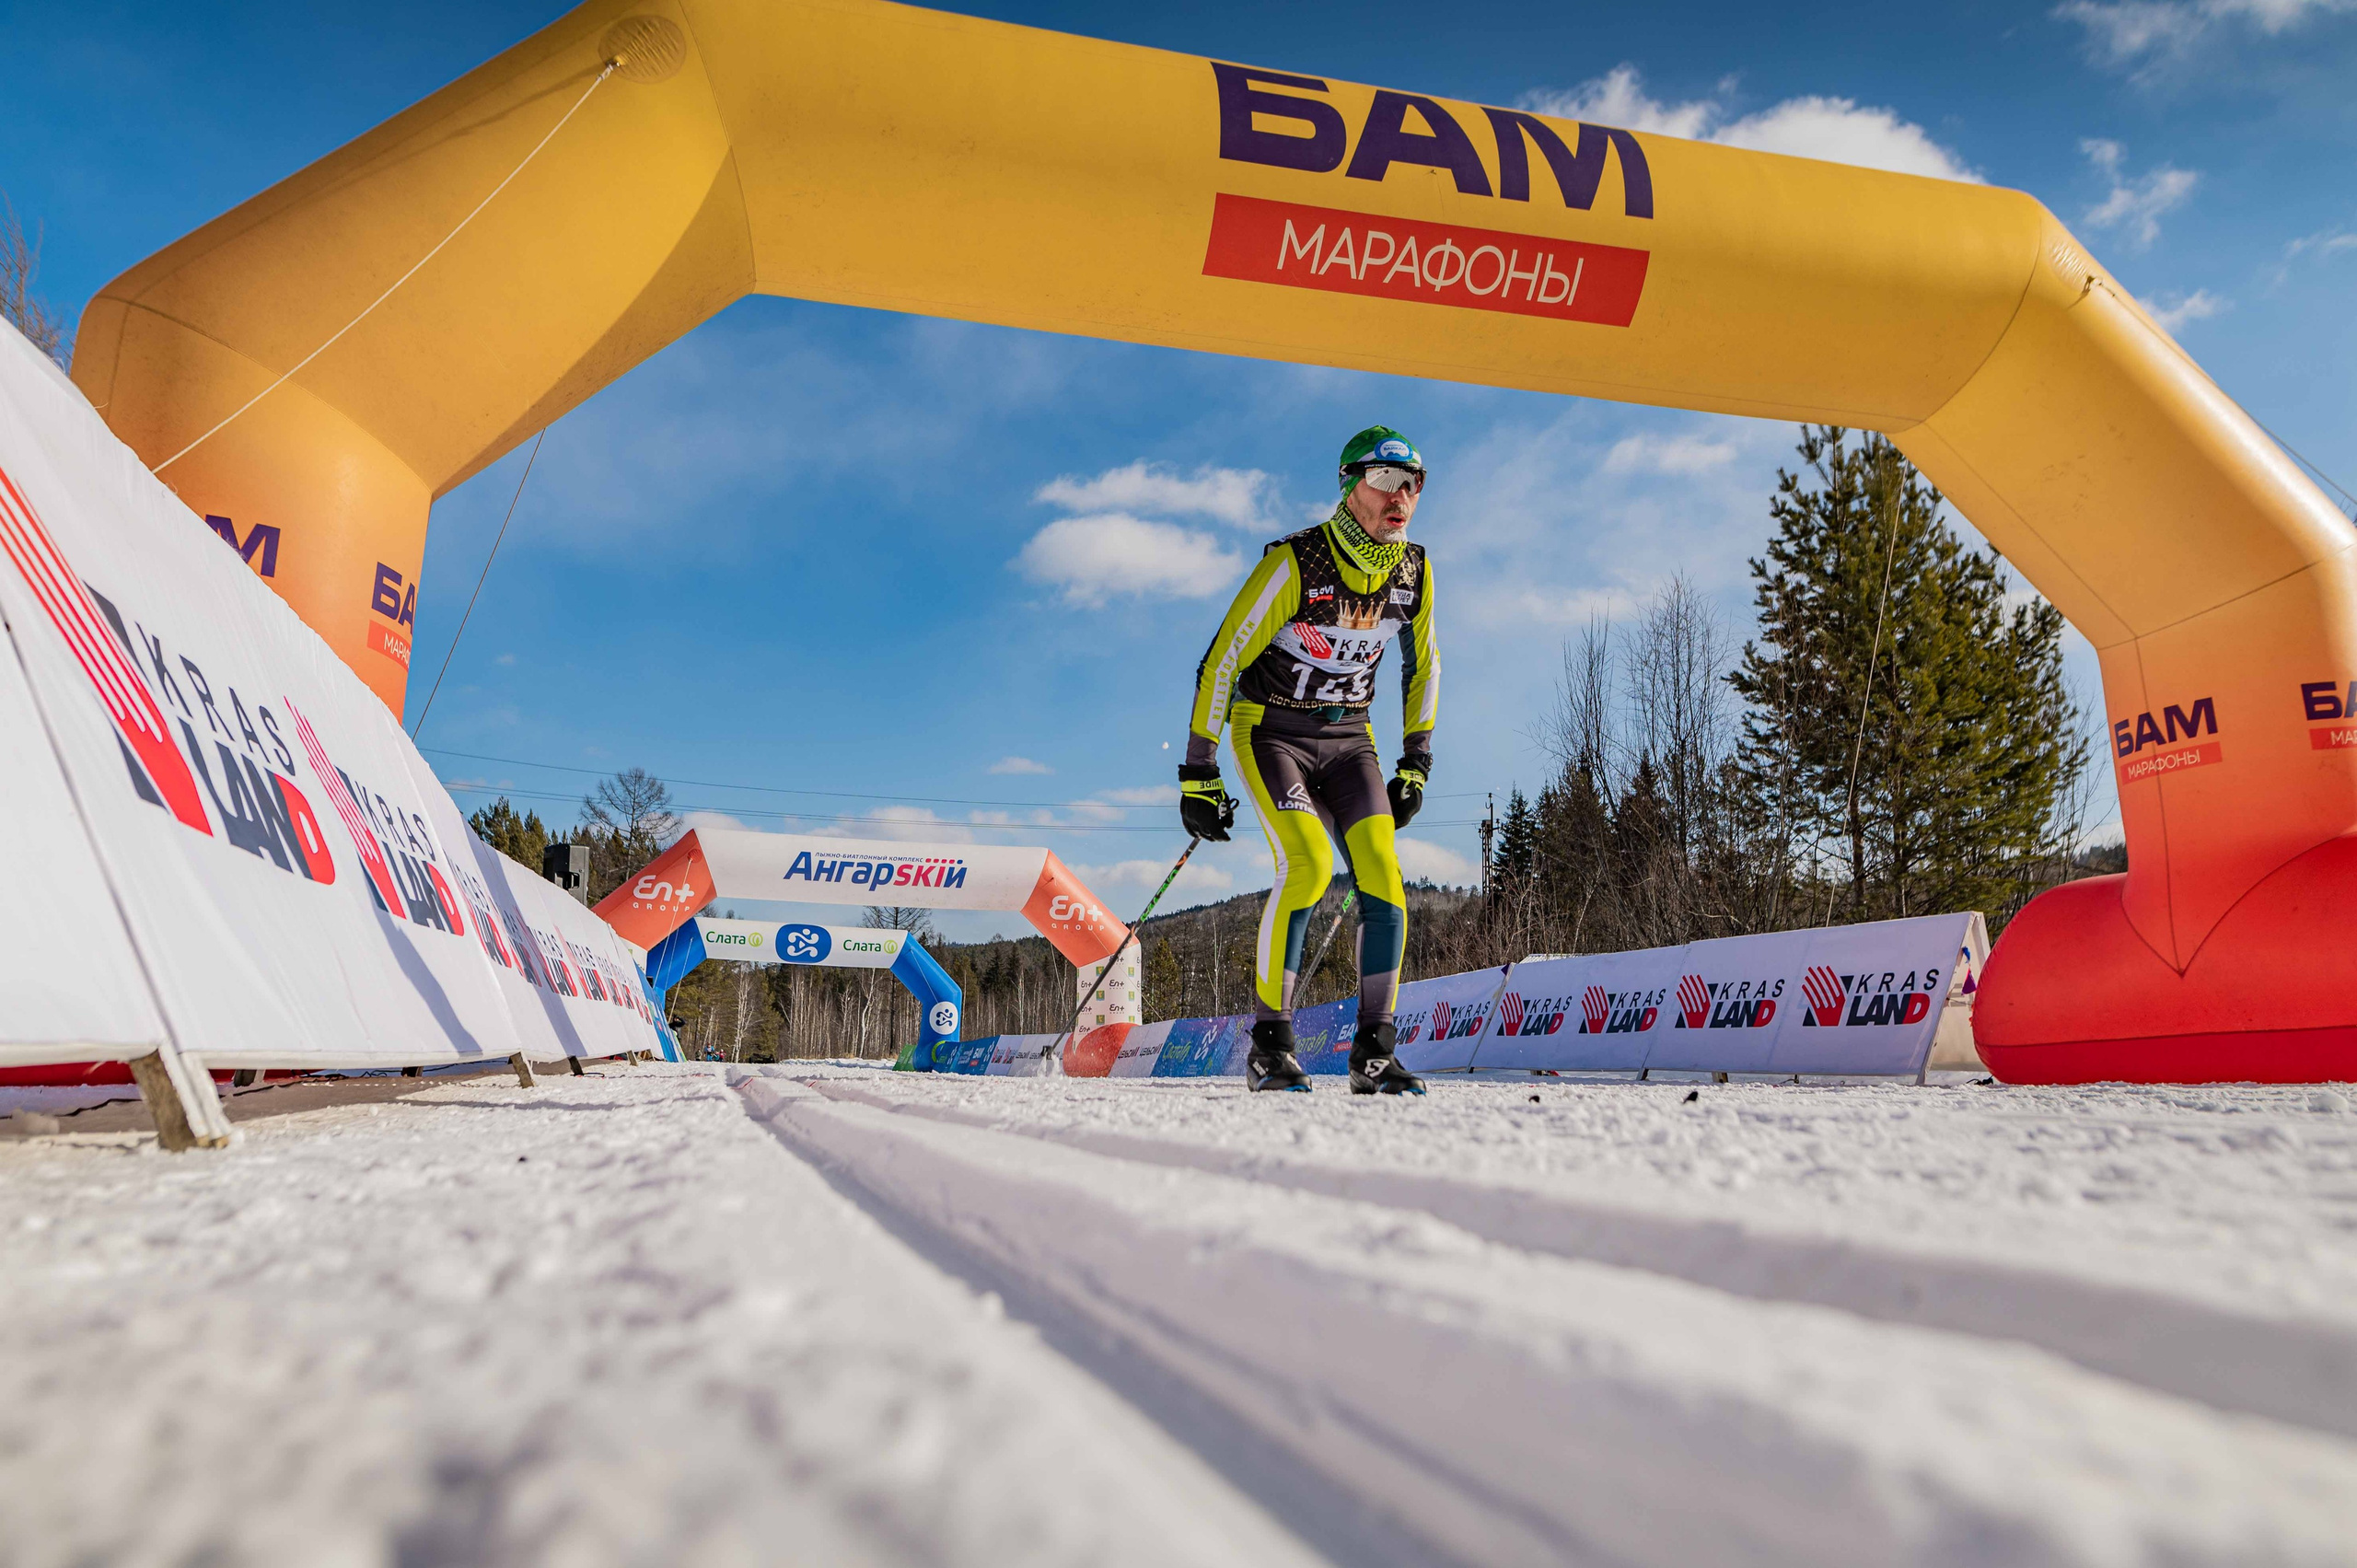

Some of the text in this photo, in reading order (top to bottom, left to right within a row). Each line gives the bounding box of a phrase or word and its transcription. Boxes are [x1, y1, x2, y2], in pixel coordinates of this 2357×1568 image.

[1210, 61, 1654, 220] БАМ
[1277, 219, 1584, 306] МАРАФОНЫ
[372, 562, 415, 635] БА
[1340, 639, 1382, 651] KRA
[134, 621, 296, 776] KRAS
[2114, 697, 2218, 758] БАМ
[2128, 749, 2200, 779] МАРАФОНЫ
[177, 715, 335, 885] LAND
[355, 781, 435, 861] KRAS
[382, 841, 464, 936] LAND
[633, 902, 690, 912] GROUP
[706, 931, 746, 945] Слата
[1051, 923, 1104, 931] GROUP
[843, 939, 881, 952] Слата
[1720, 979, 1785, 999] KRAS
[1855, 969, 1940, 993] KRAS
[1457, 1001, 1491, 1019] KRAS
[1530, 995, 1573, 1013] KRAS
[1616, 988, 1666, 1008] KRAS
[1846, 993, 1931, 1027] LAND
[1398, 1011, 1426, 1026] KRAS
[1520, 1013, 1564, 1037] LAND
[1606, 1007, 1656, 1033] LAND
[1709, 999, 1776, 1028] LAND
[1338, 1023, 1358, 1040] БА
[1395, 1025, 1421, 1045] AND
[1447, 1016, 1483, 1040] LAND
